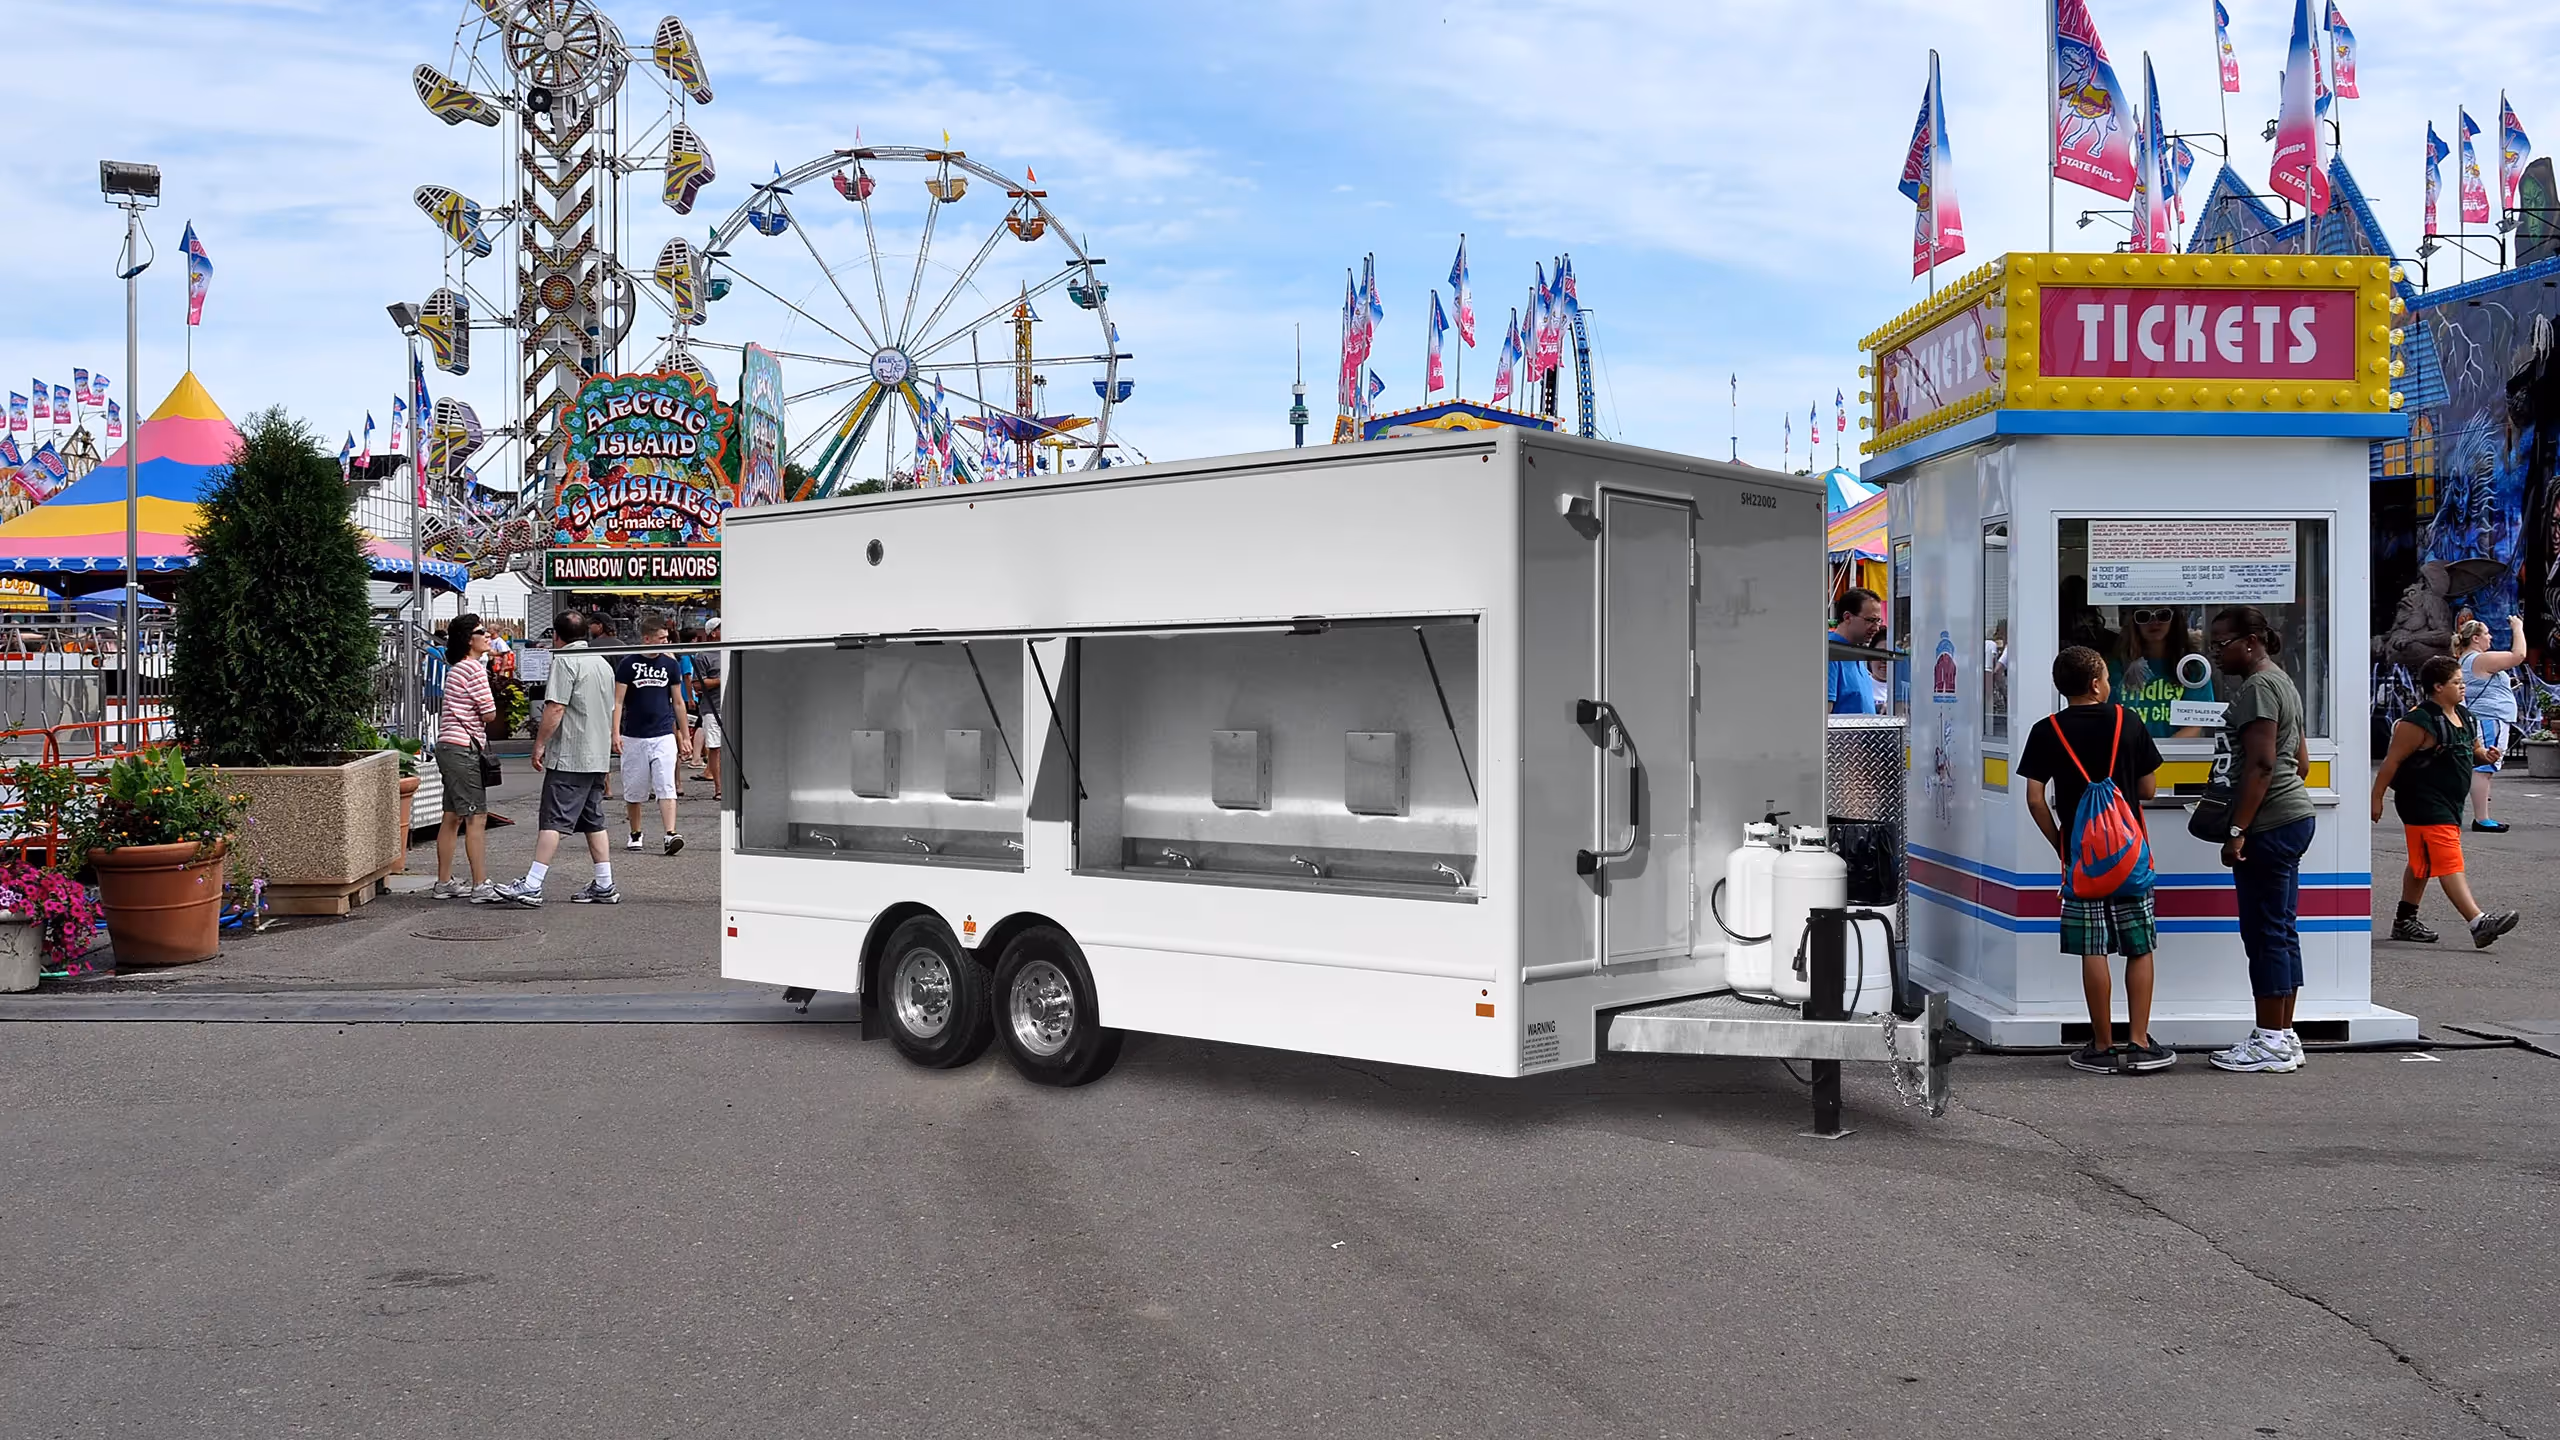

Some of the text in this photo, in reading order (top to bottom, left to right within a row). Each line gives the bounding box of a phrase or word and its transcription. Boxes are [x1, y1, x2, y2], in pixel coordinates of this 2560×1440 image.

[2060, 155, 2118, 182] STATE FAIR
[2077, 303, 2317, 364] TICKETS
[585, 391, 708, 435] ARCTIC
[596, 432, 698, 457] ISLAND
[38, 451, 65, 476] MIDWAY
[570, 475, 723, 528] SLUSHIES
[1741, 492, 1777, 509] SH22002
[608, 515, 684, 530] u-make-it
[555, 556, 718, 579] RAINBOW OF FLAVORS
[632, 662, 668, 679] Fitch
[1527, 1020, 1556, 1036] WARNING
